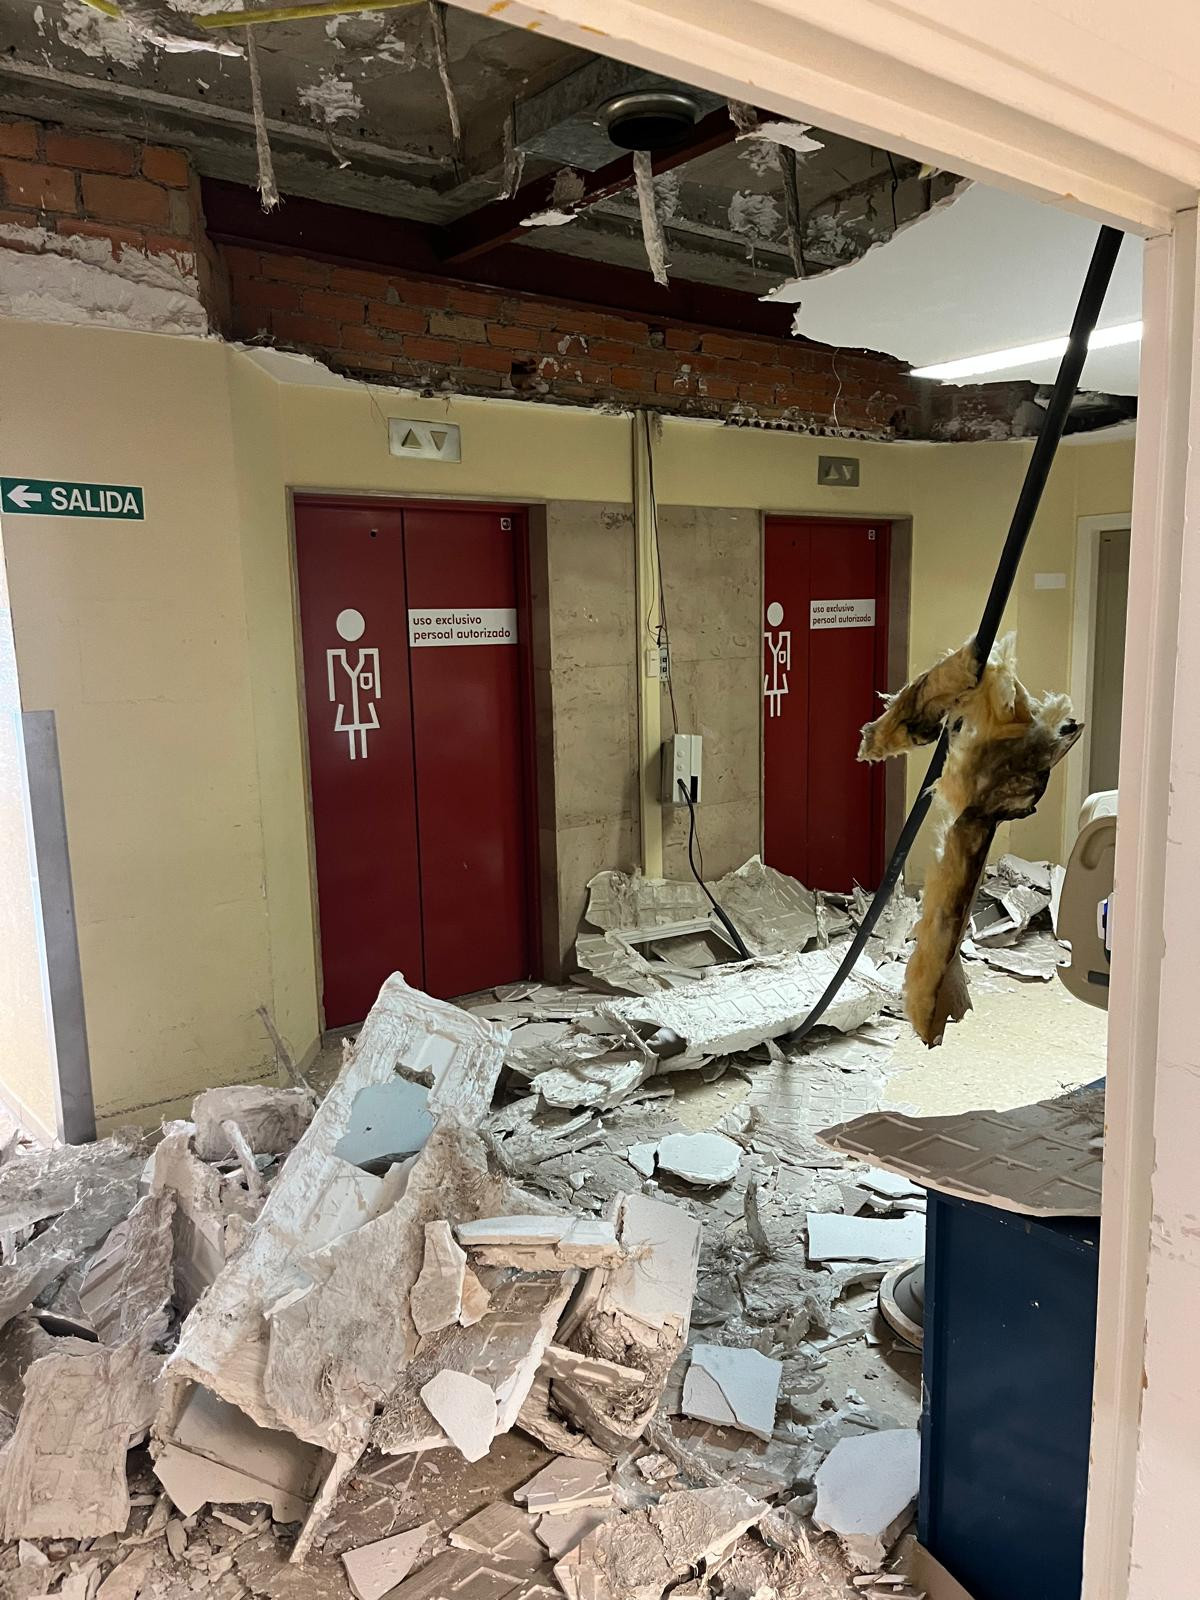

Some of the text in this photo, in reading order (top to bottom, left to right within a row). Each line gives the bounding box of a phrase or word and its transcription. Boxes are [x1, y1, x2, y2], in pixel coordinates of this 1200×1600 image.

[51, 487, 139, 514] SALIDA
[826, 604, 855, 613] exclusivo
[413, 614, 482, 625] uso exclusivo
[812, 614, 872, 627] persoal autorizado
[413, 627, 511, 643] persoal autorizado
